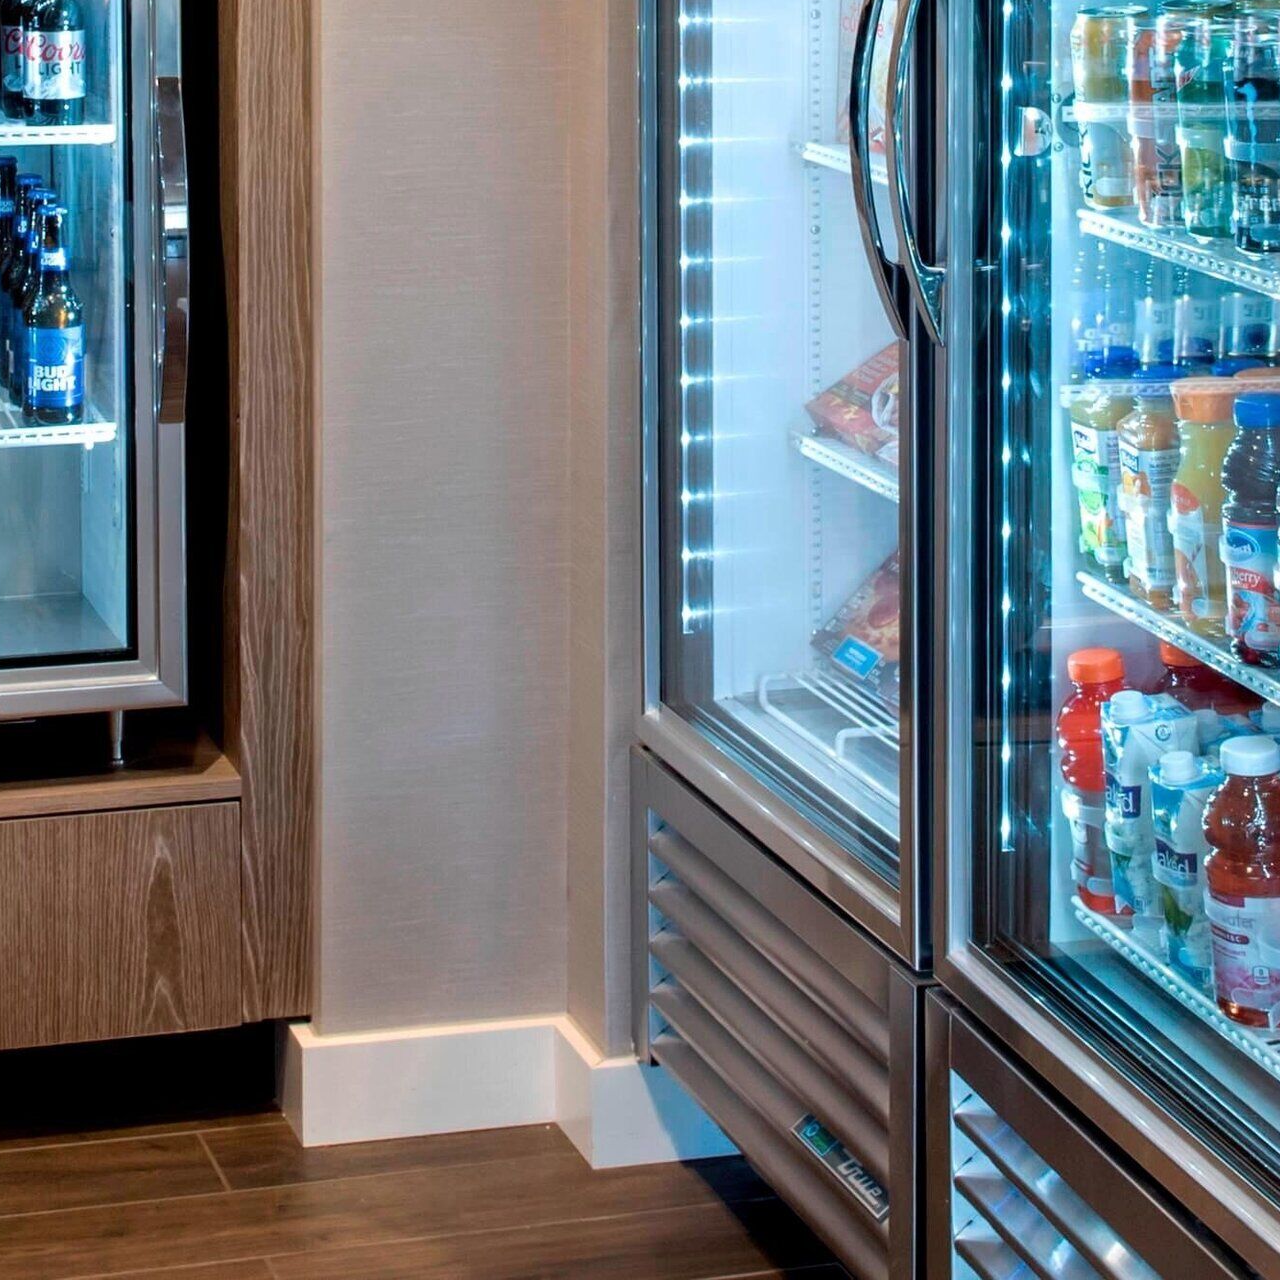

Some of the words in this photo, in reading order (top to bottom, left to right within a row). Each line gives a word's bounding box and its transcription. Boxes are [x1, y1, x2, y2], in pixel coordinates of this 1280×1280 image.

[33, 365, 69, 379] BUD
[28, 376, 76, 394] LIGHT
[837, 1149, 883, 1209] True
